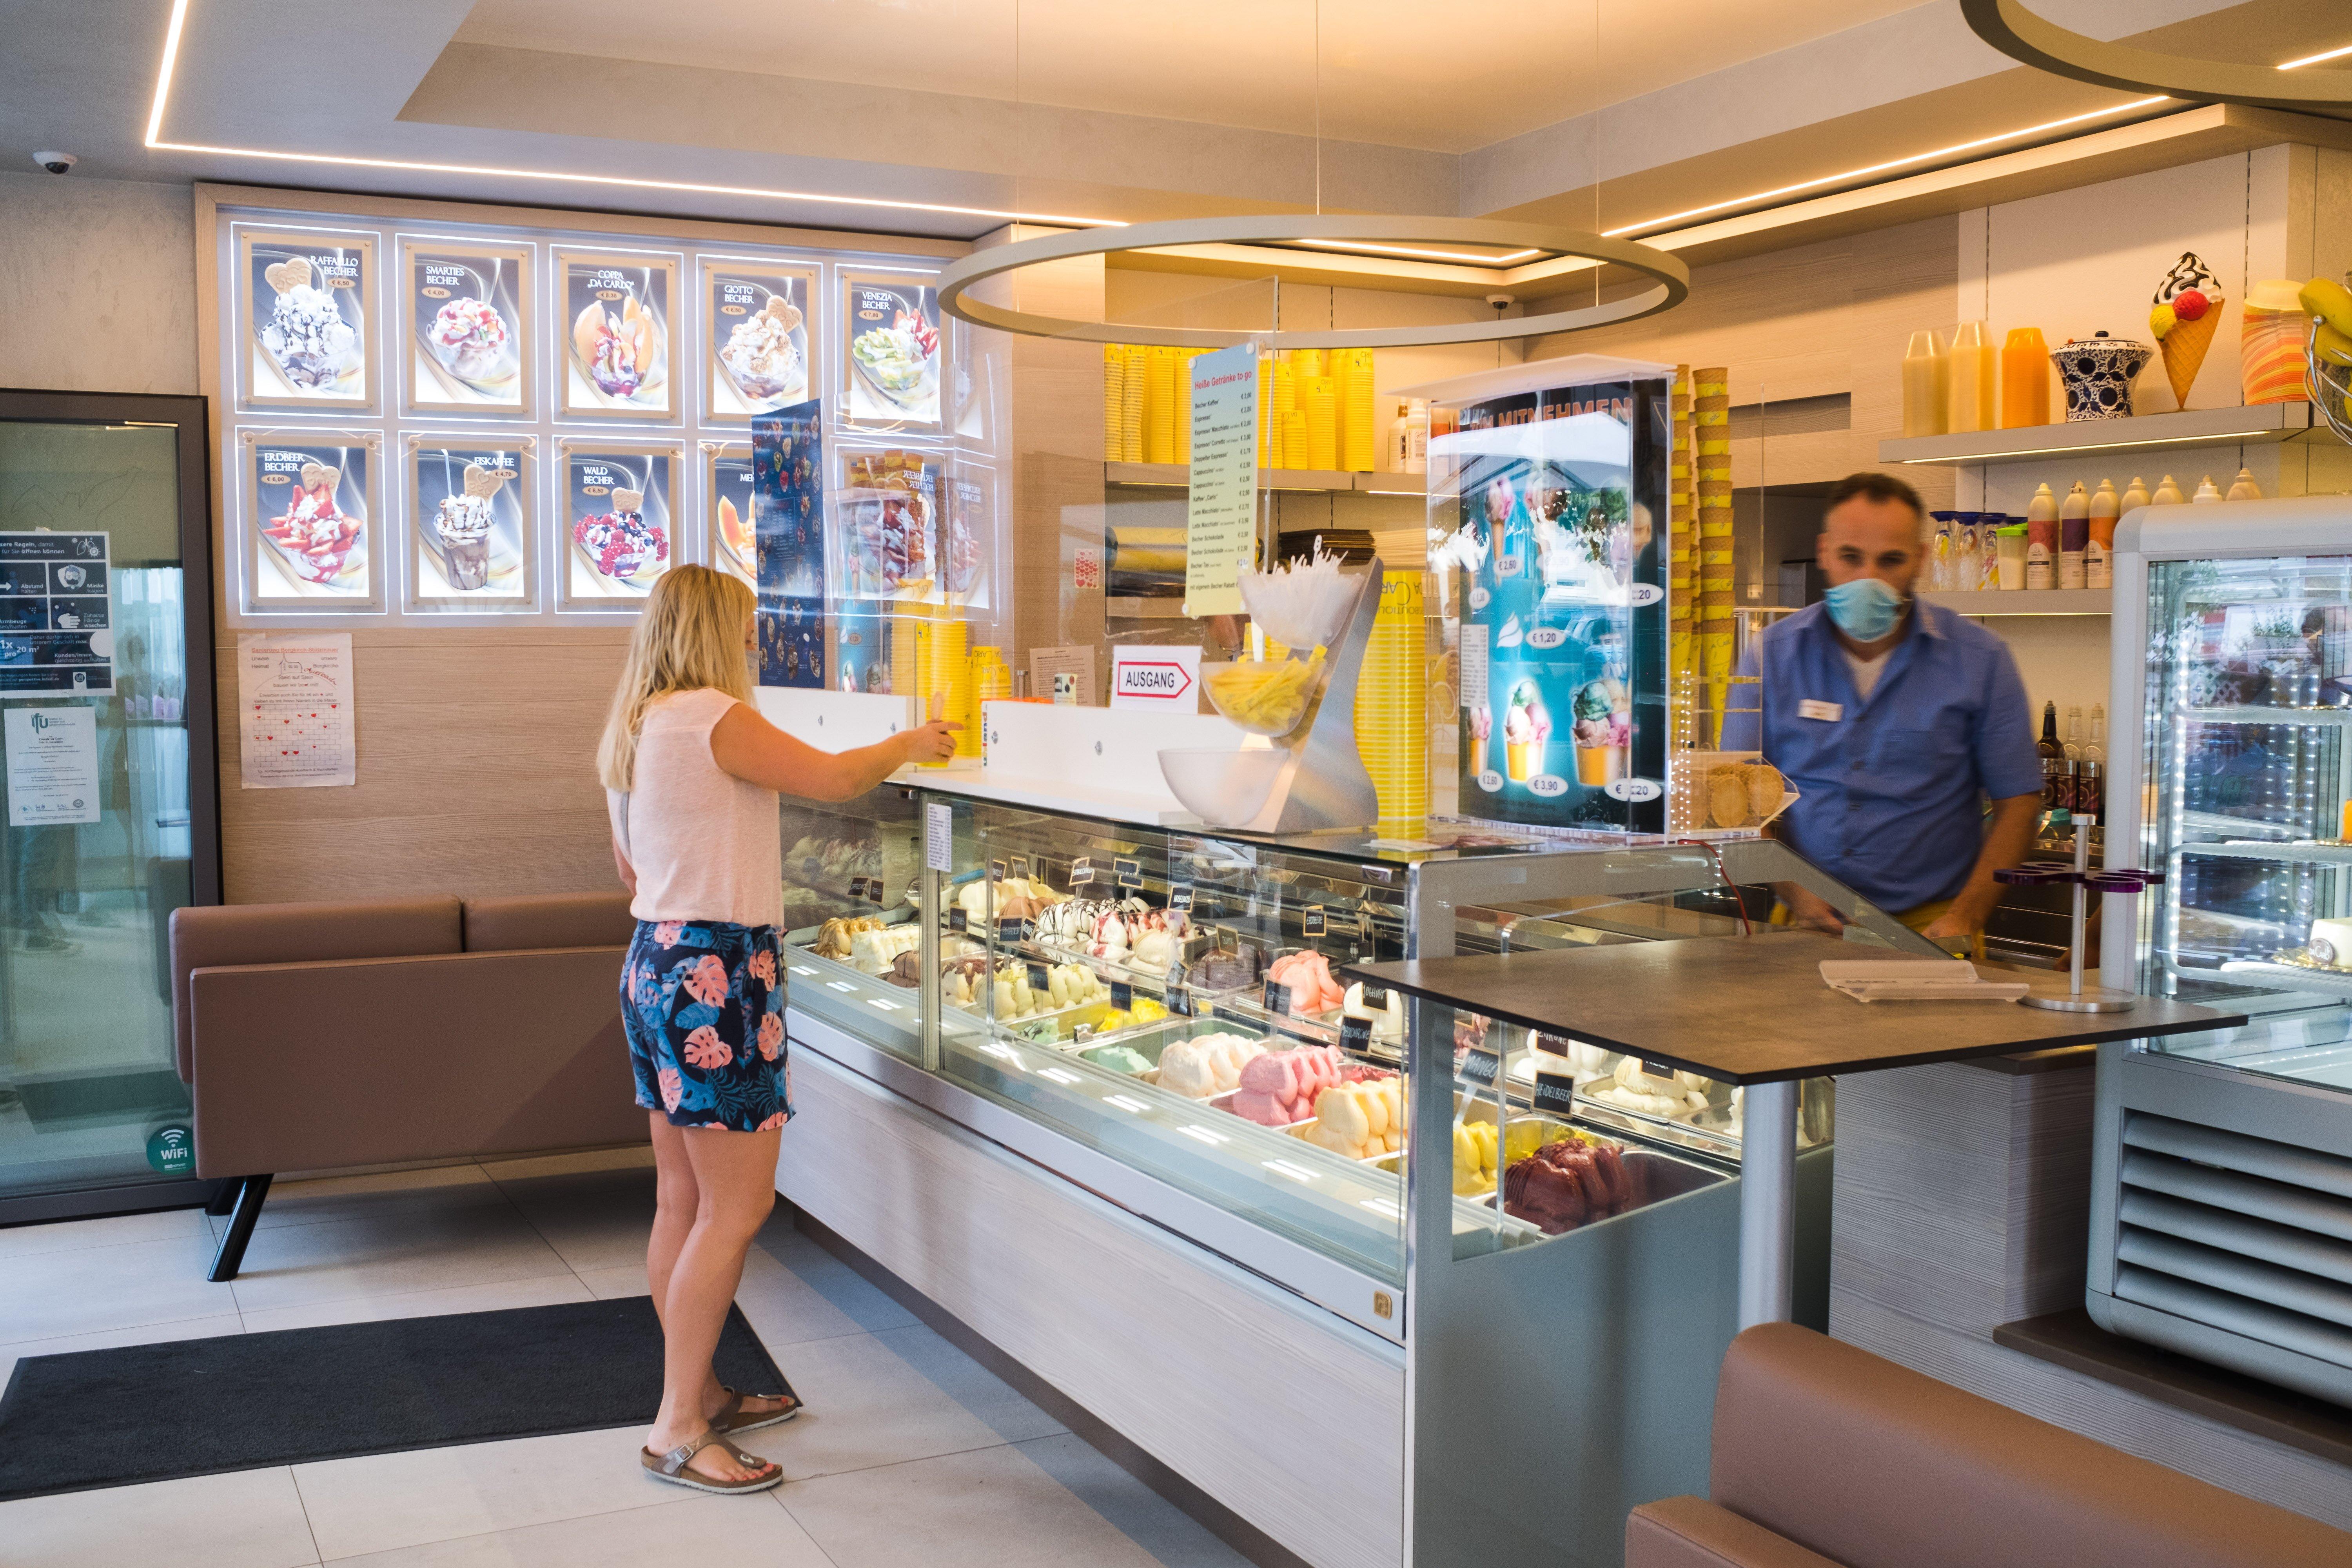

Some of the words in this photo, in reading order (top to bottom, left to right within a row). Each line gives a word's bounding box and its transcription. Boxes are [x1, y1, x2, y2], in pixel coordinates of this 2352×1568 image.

[324, 266, 358, 276] BECHER
[426, 265, 465, 276] SMARTIES
[598, 270, 624, 279] COPPA
[426, 275, 460, 285] BECHER
[724, 285, 753, 295] GIOTTO
[725, 294, 755, 304] BECHER
[862, 291, 892, 301] VENEZIA
[862, 300, 891, 310] BECHER
[1195, 379, 1210, 390] Heiße
[1212, 374, 1236, 386] Getränke
[1238, 372, 1243, 381] to
[1245, 371, 1252, 381] go
[1498, 397, 1632, 428] MITNEHMEN
[264, 452, 305, 462] ERDBEER
[265, 462, 300, 471] BECHER
[583, 466, 608, 475] WALD
[583, 475, 615, 485] BECHER
[1499, 562, 1502, 570] €
[1382, 581, 1410, 606] CAR
[1533, 633, 1537, 642] €
[1540, 633, 1556, 643] 1,20
[1126, 671, 1175, 688] AUSGANG
[1534, 780, 1539, 789] €
[1541, 781, 1557, 792] 3,90
[1615, 785, 1621, 794] €
[1363, 984, 1387, 1000] JOGHURT
[1466, 1054, 1498, 1078] MANGO
[161, 1147, 188, 1160] WiFi
